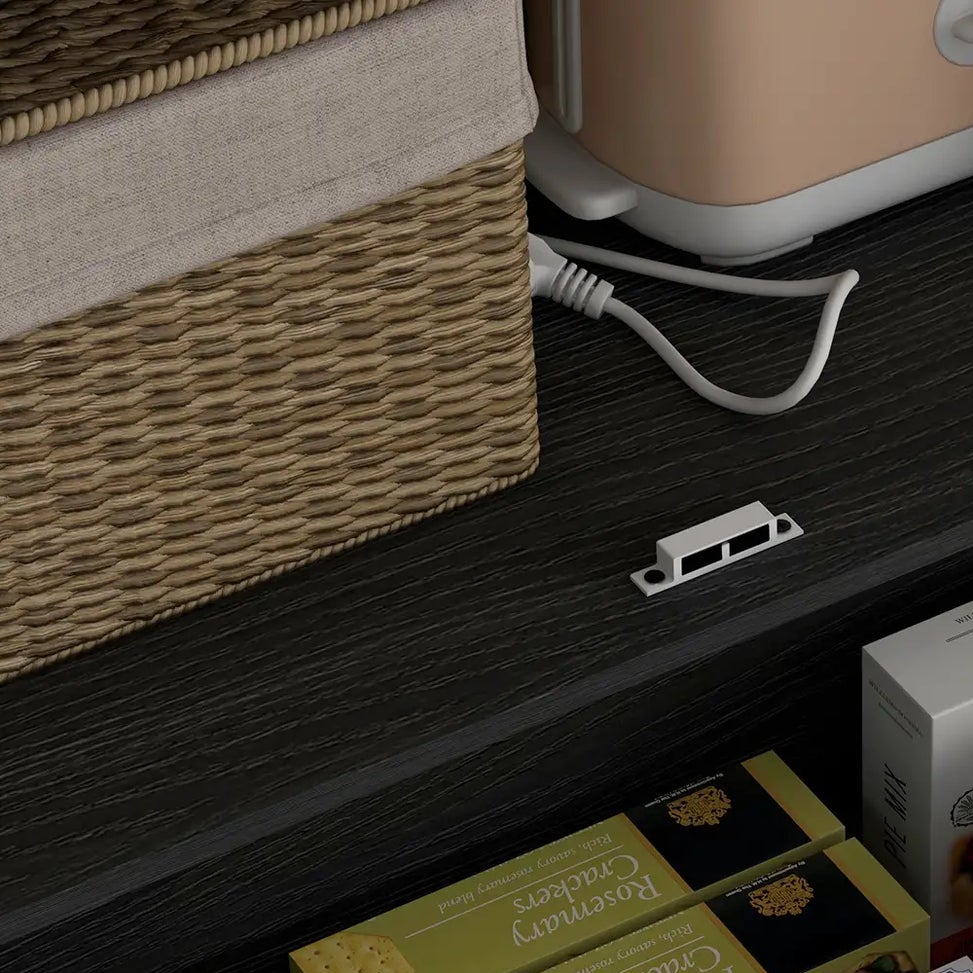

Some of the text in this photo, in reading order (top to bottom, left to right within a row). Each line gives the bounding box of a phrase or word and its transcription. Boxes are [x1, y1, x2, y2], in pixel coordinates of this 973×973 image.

[884, 763, 907, 870] PIE MIX
[438, 891, 474, 914] blend
[477, 865, 534, 895] rosemary
[512, 873, 663, 947] Rosemary
[513, 854, 640, 914] Crackers
